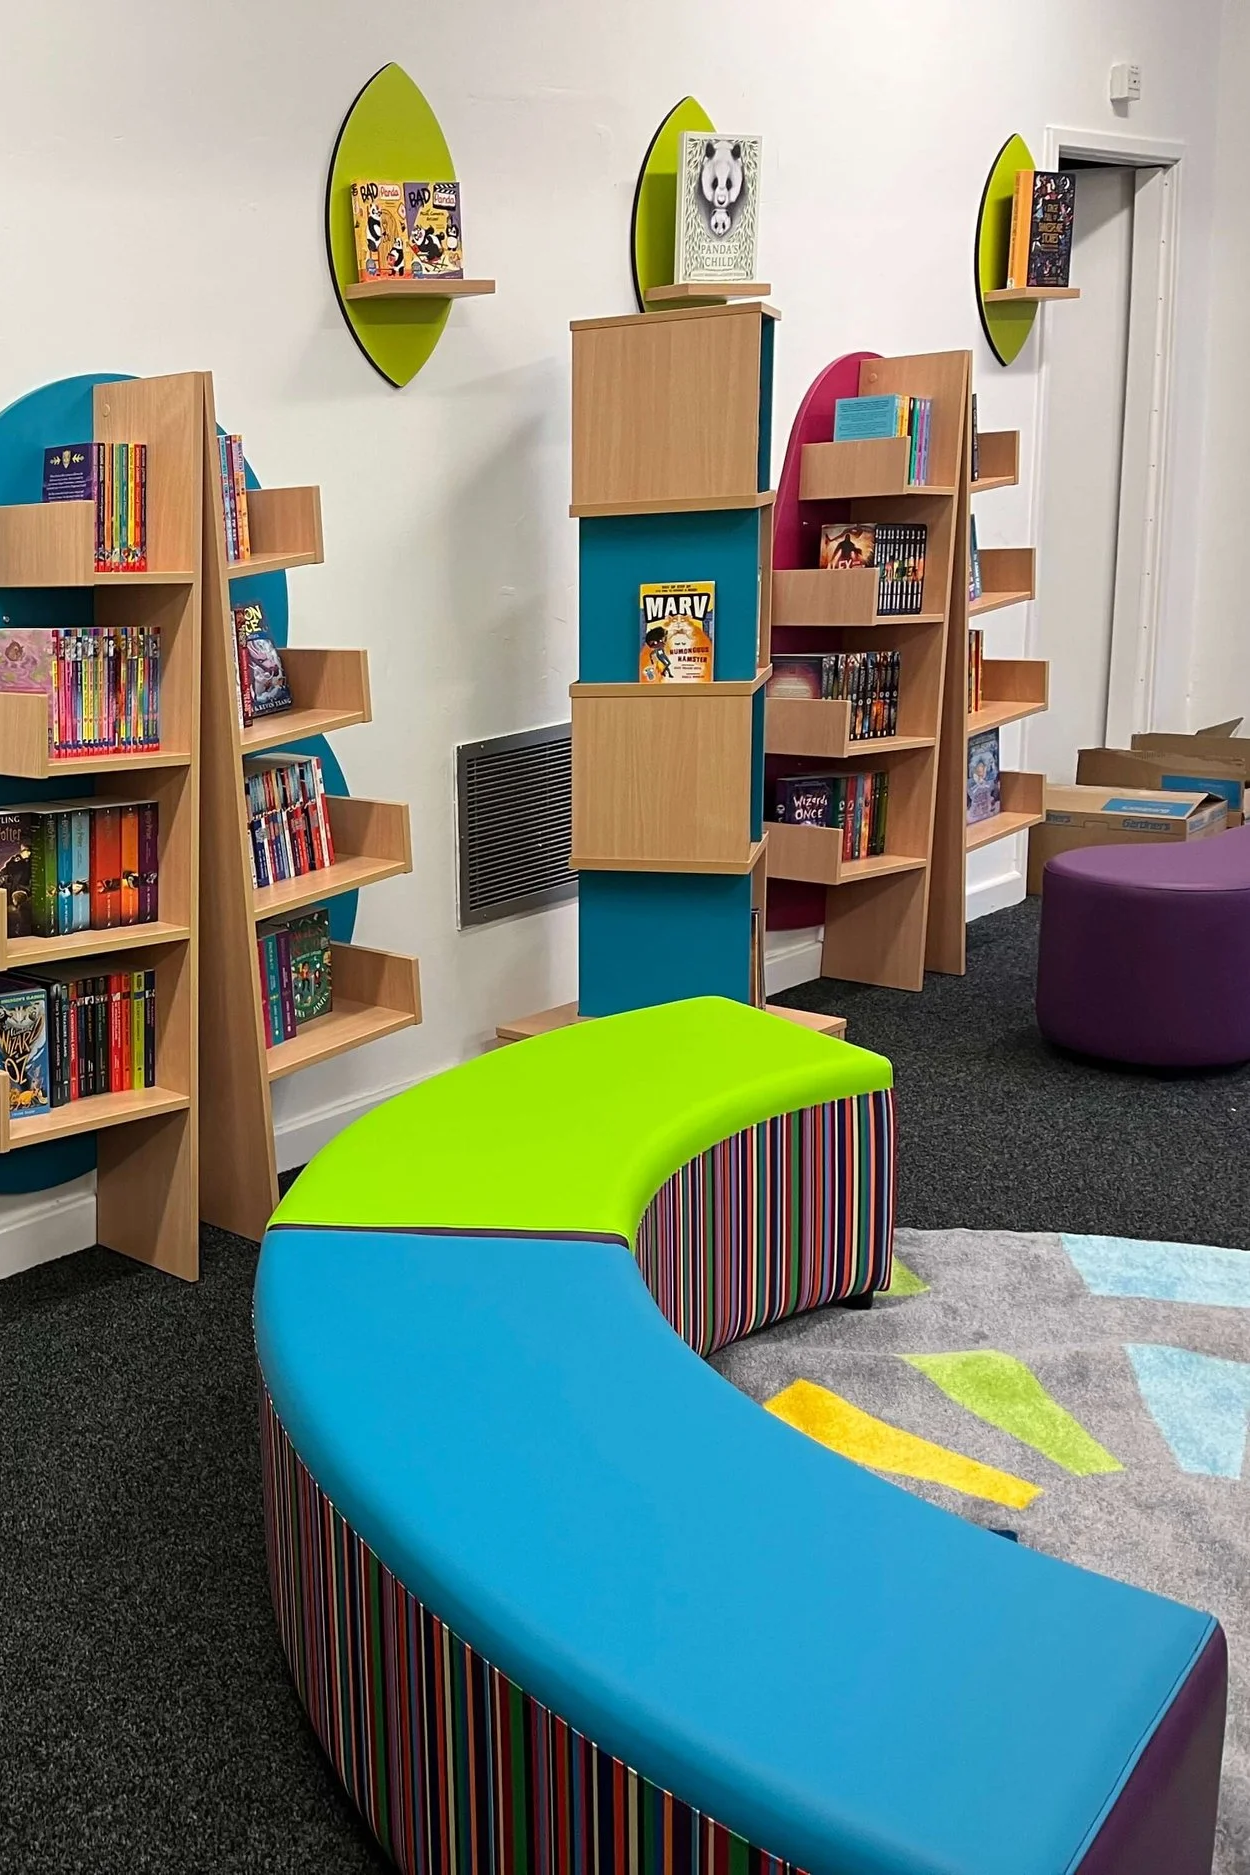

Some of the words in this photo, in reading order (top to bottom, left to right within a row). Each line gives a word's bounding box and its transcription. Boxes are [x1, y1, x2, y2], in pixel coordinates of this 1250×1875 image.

[360, 183, 378, 203] BAD
[380, 186, 399, 198] Panda
[409, 188, 430, 207] BAD
[434, 194, 454, 204] Panda
[700, 244, 739, 255] PANDA'S
[704, 256, 734, 267] CHILD
[645, 595, 708, 620] MARV
[670, 647, 709, 655] HUMONGOUS
[793, 795, 827, 808] Wizards
[795, 809, 823, 820] ONCE
[1122, 818, 1171, 831] Gardners
[5, 1055, 30, 1084] OZ
